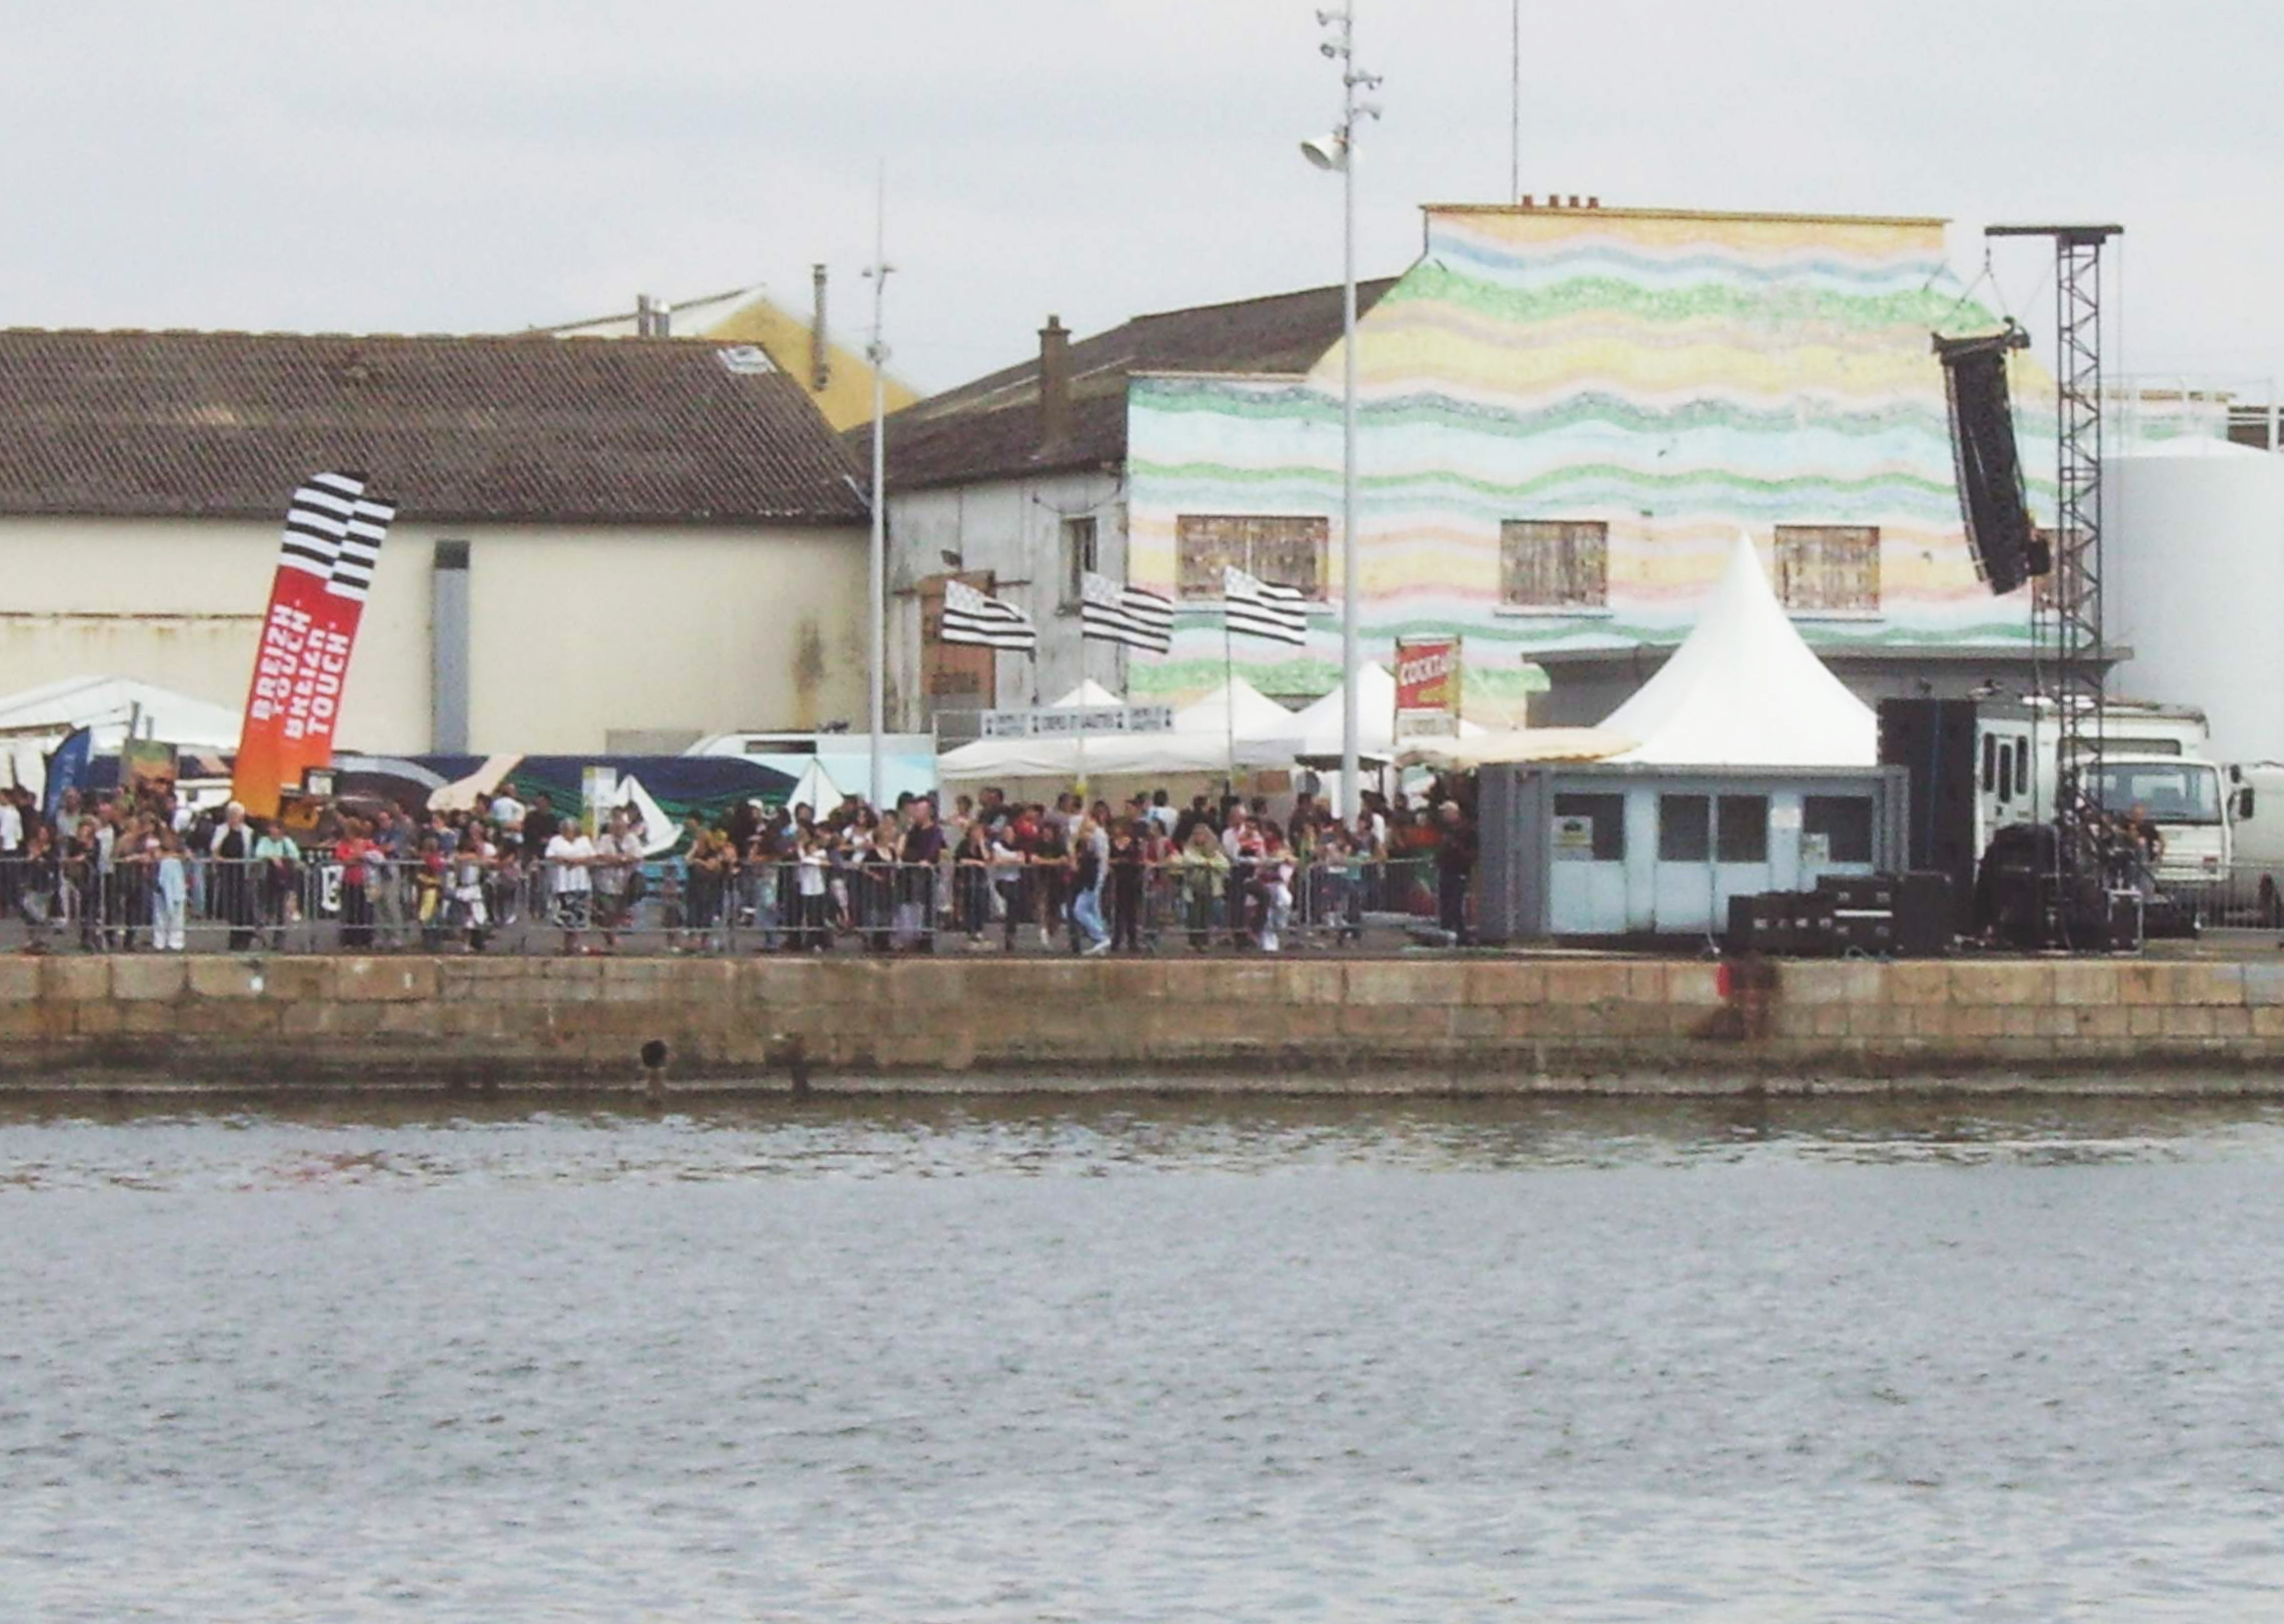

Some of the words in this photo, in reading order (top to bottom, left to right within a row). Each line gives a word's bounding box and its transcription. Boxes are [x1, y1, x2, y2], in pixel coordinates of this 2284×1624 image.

[252, 605, 292, 720] BREIZH
[273, 610, 311, 715] TOUCH
[307, 634, 349, 736] TOUCH
